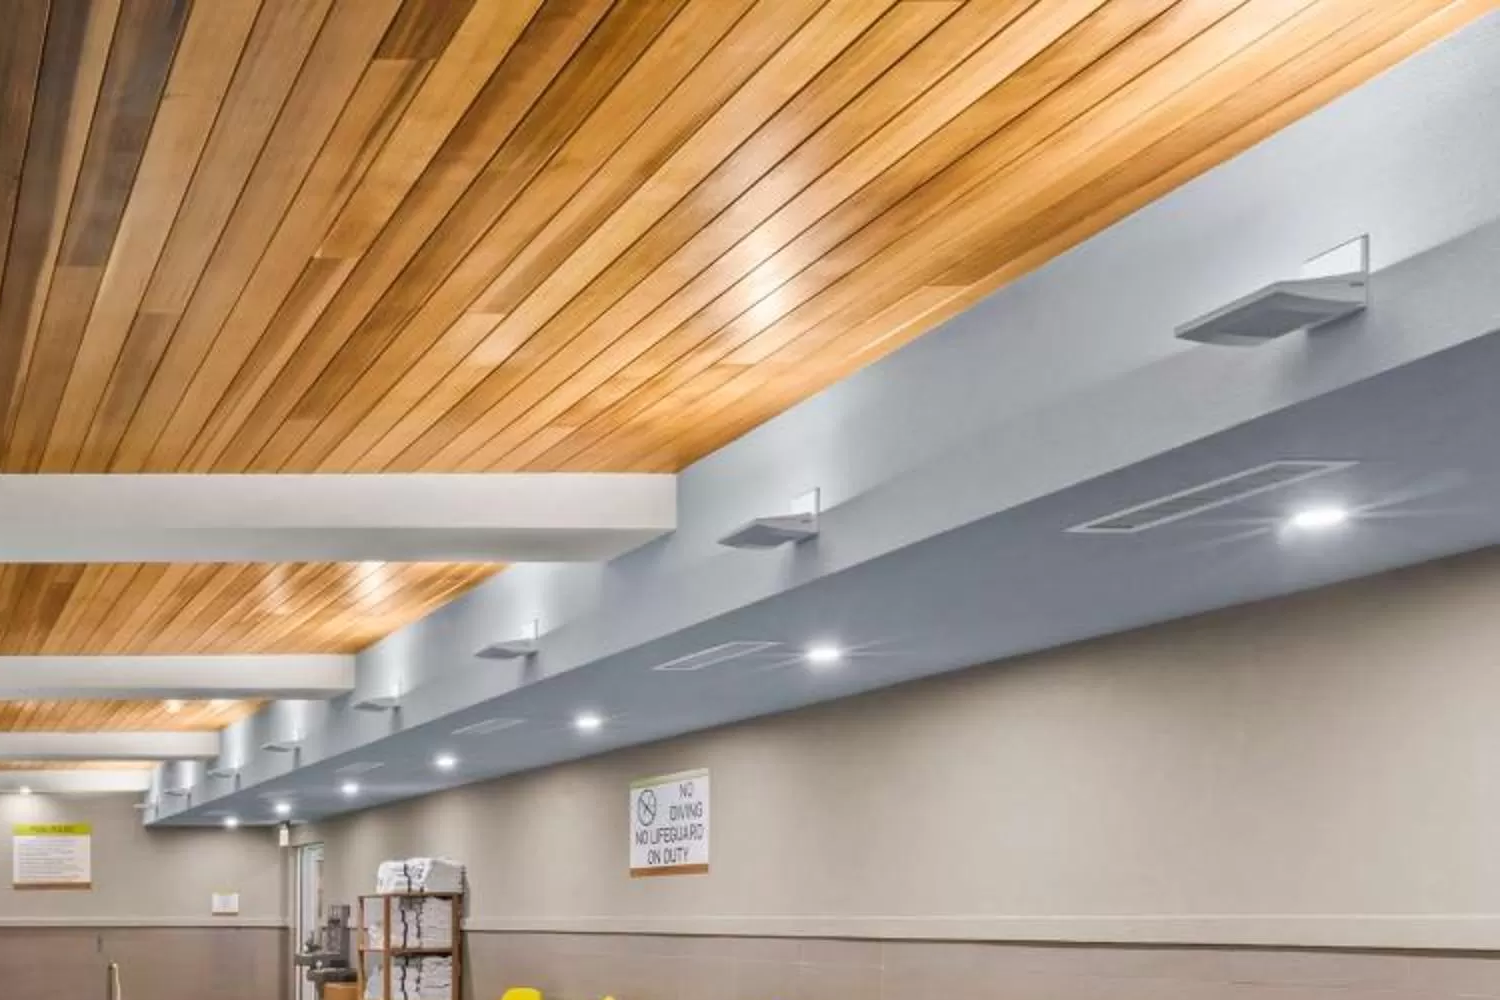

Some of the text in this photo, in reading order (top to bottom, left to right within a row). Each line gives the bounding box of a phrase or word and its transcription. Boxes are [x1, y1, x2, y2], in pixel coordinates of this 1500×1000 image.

[679, 782, 693, 797] NO
[669, 801, 703, 821] DIVING
[636, 823, 704, 845] NO LIFEGUARD
[647, 847, 689, 865] ON DUTY
